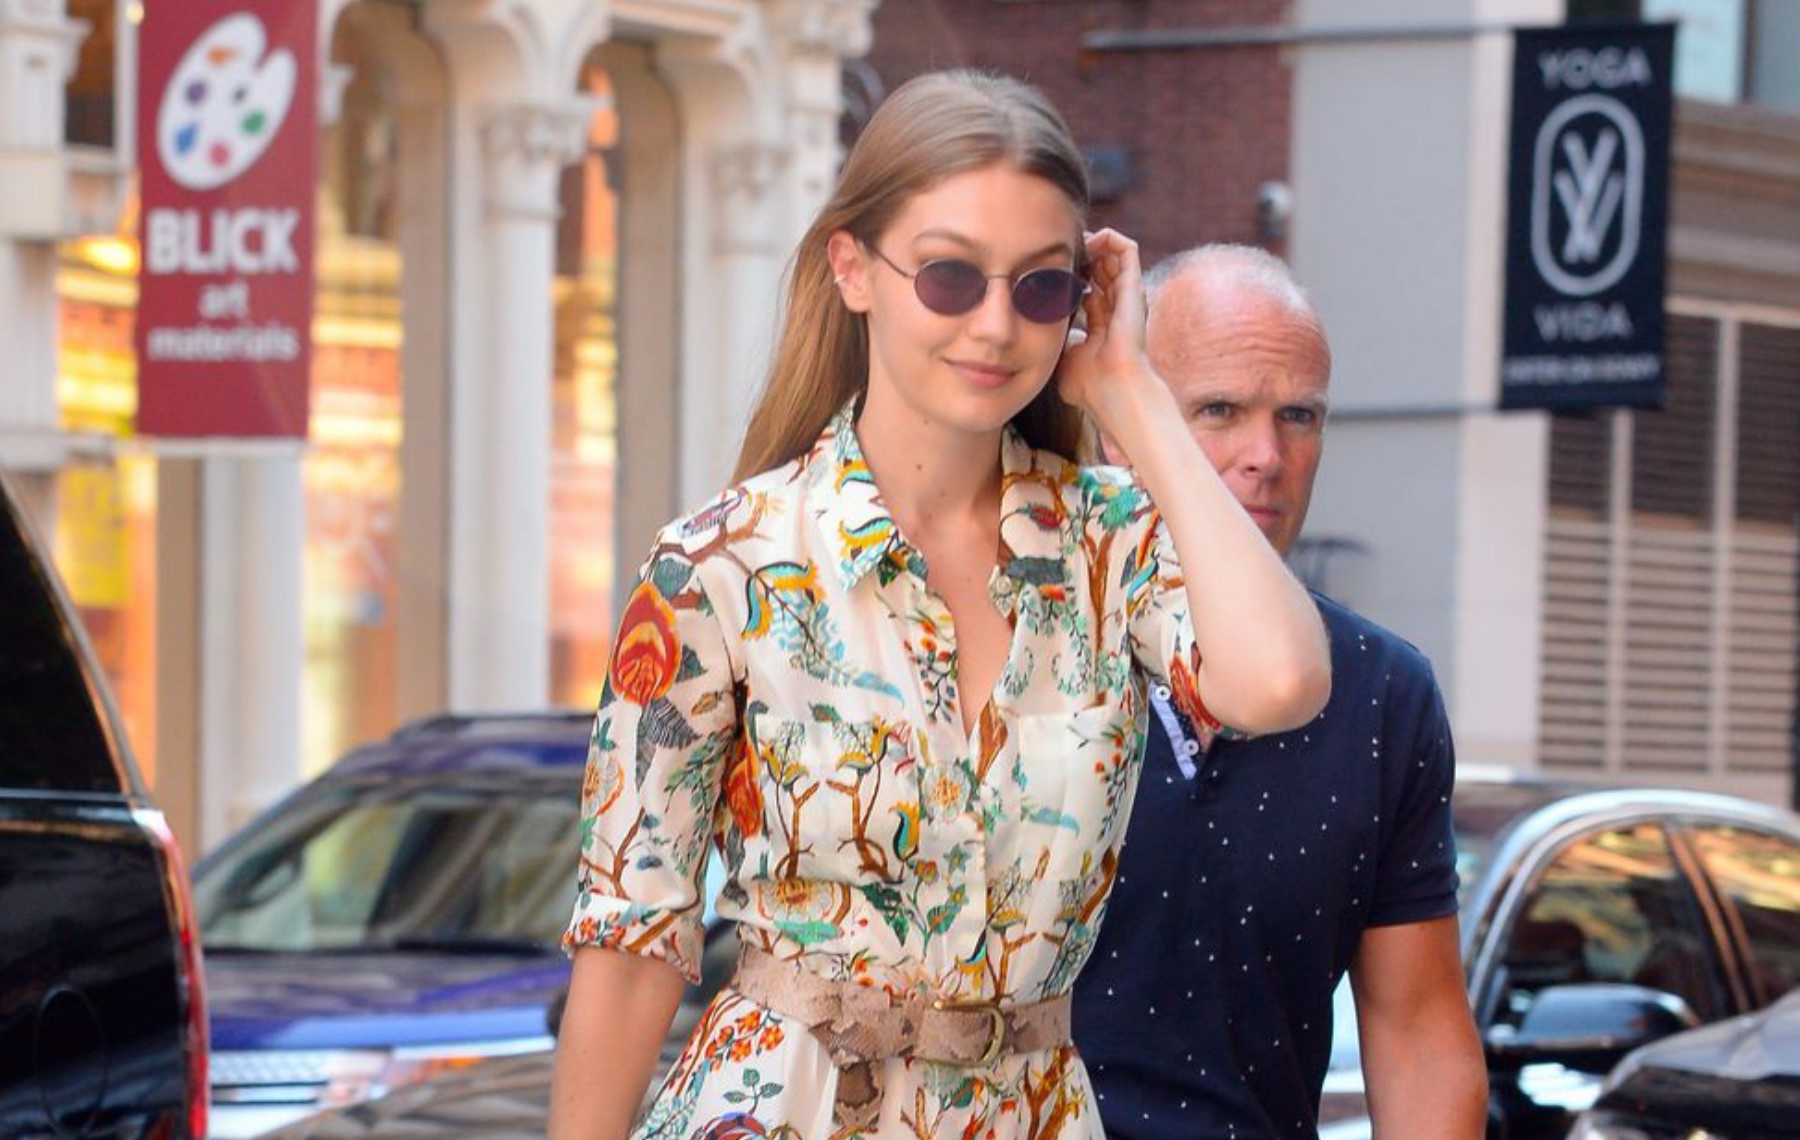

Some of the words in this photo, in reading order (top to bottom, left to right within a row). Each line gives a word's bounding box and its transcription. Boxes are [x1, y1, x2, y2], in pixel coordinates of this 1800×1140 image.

[1538, 47, 1653, 89] YOGA
[146, 206, 299, 275] BLICK
[199, 279, 249, 319] art
[146, 322, 298, 362] materials
[1533, 301, 1634, 342] VIDA
